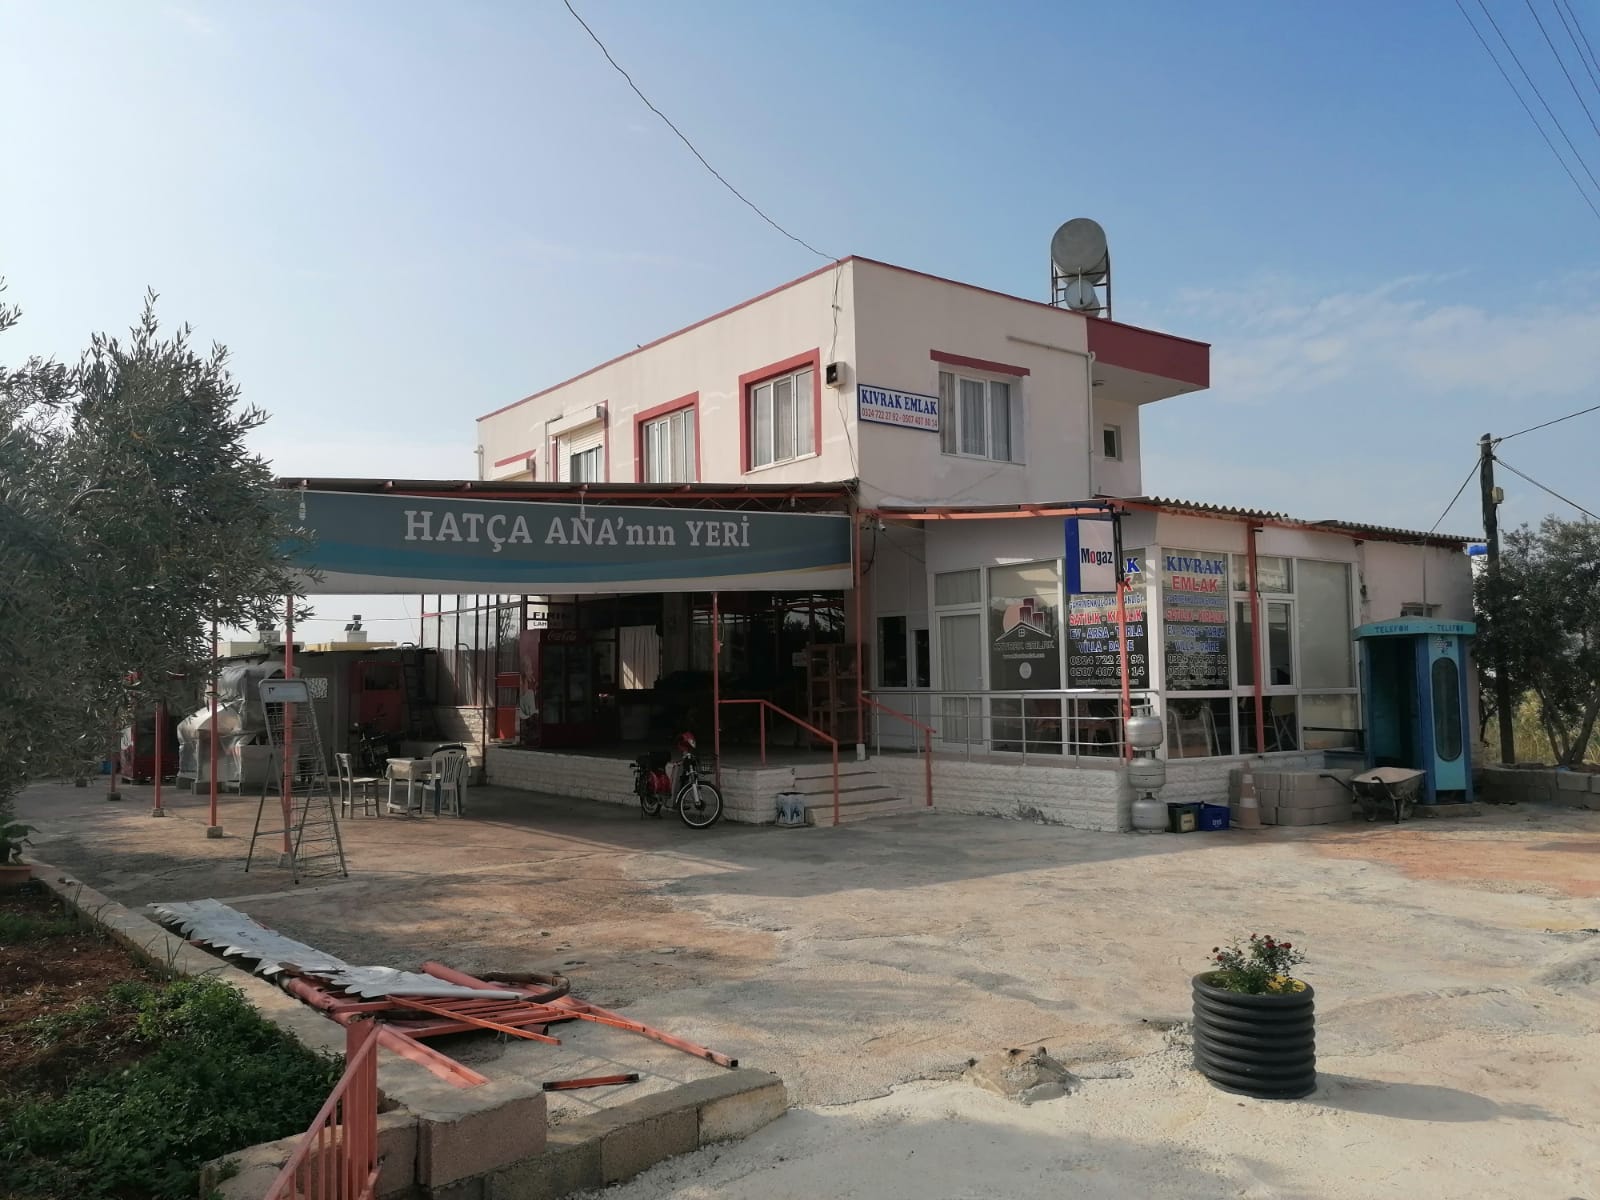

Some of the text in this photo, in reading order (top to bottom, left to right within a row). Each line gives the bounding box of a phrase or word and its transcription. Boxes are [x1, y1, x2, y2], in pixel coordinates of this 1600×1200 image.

[862, 389, 938, 415] KIVRAK EMLAK
[403, 510, 752, 553] HATÇA ANA'nın YERİ
[1081, 548, 1113, 566] Mogaz
[1166, 556, 1223, 575] KIVRAK
[1172, 575, 1218, 592] EMLAK
[1069, 612, 1101, 626] SATILIK
[1070, 629, 1081, 639] EV
[1087, 627, 1109, 638] ARSA
[1115, 625, 1143, 637] TRLA
[1374, 624, 1408, 634] TELEFON
[1437, 624, 1464, 633] TELEFON
[1108, 640, 1134, 652] DAE
[1096, 655, 1114, 665] 722
[1096, 667, 1114, 677] 407
[1131, 666, 1144, 677] 14
